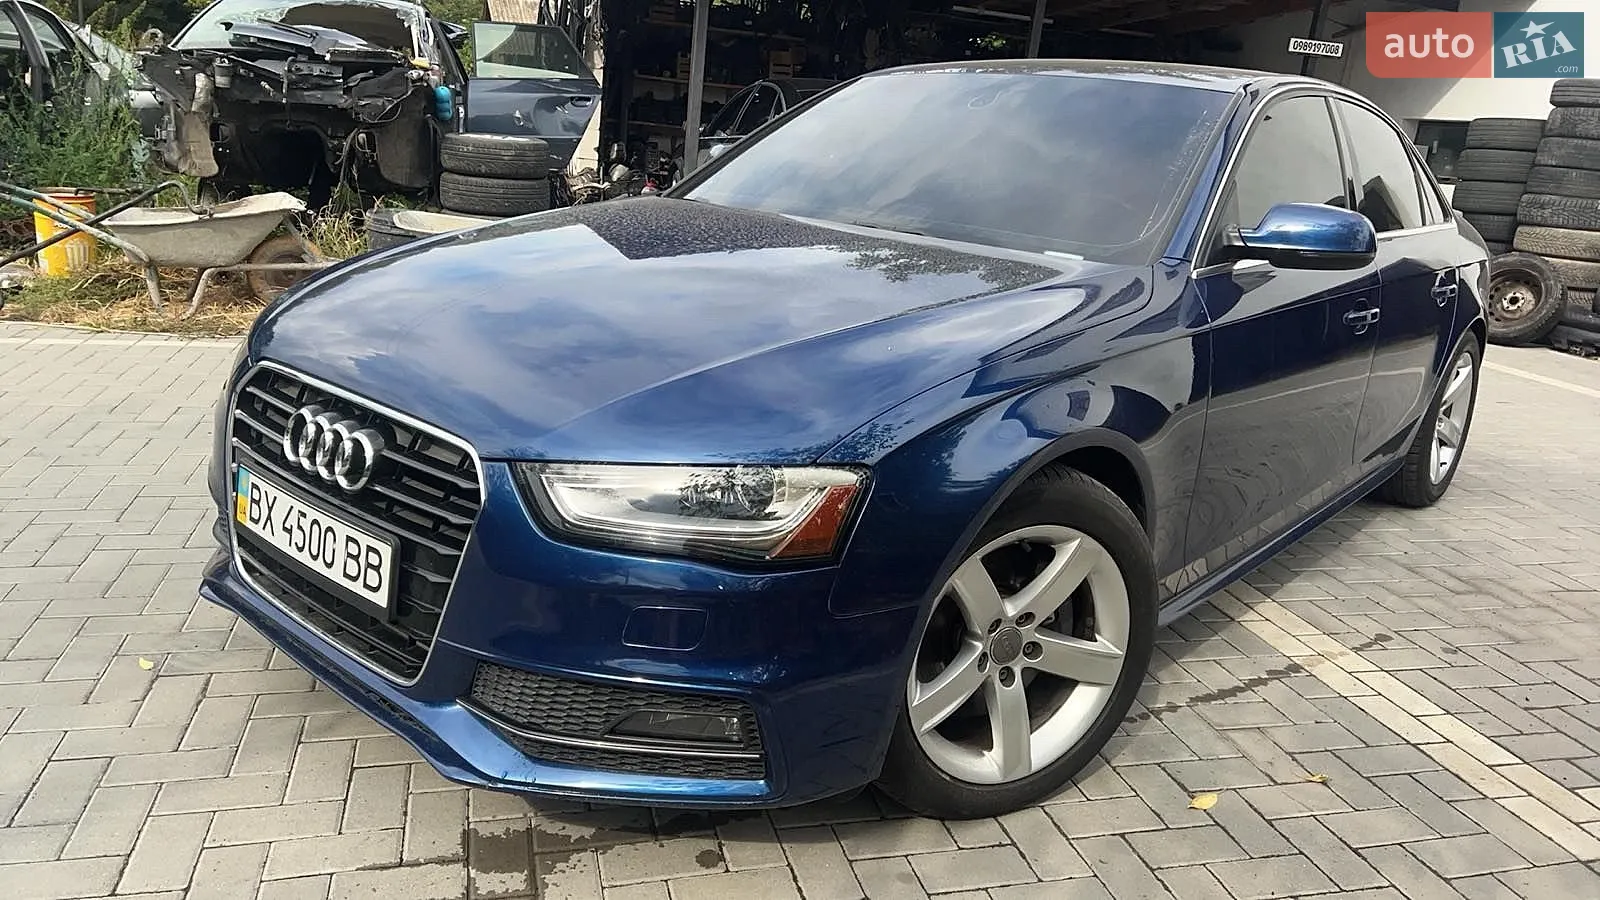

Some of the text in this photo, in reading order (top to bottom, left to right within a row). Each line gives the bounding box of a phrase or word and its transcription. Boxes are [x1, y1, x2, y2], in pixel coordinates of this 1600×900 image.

[249, 481, 383, 593] BX 4500 BB
